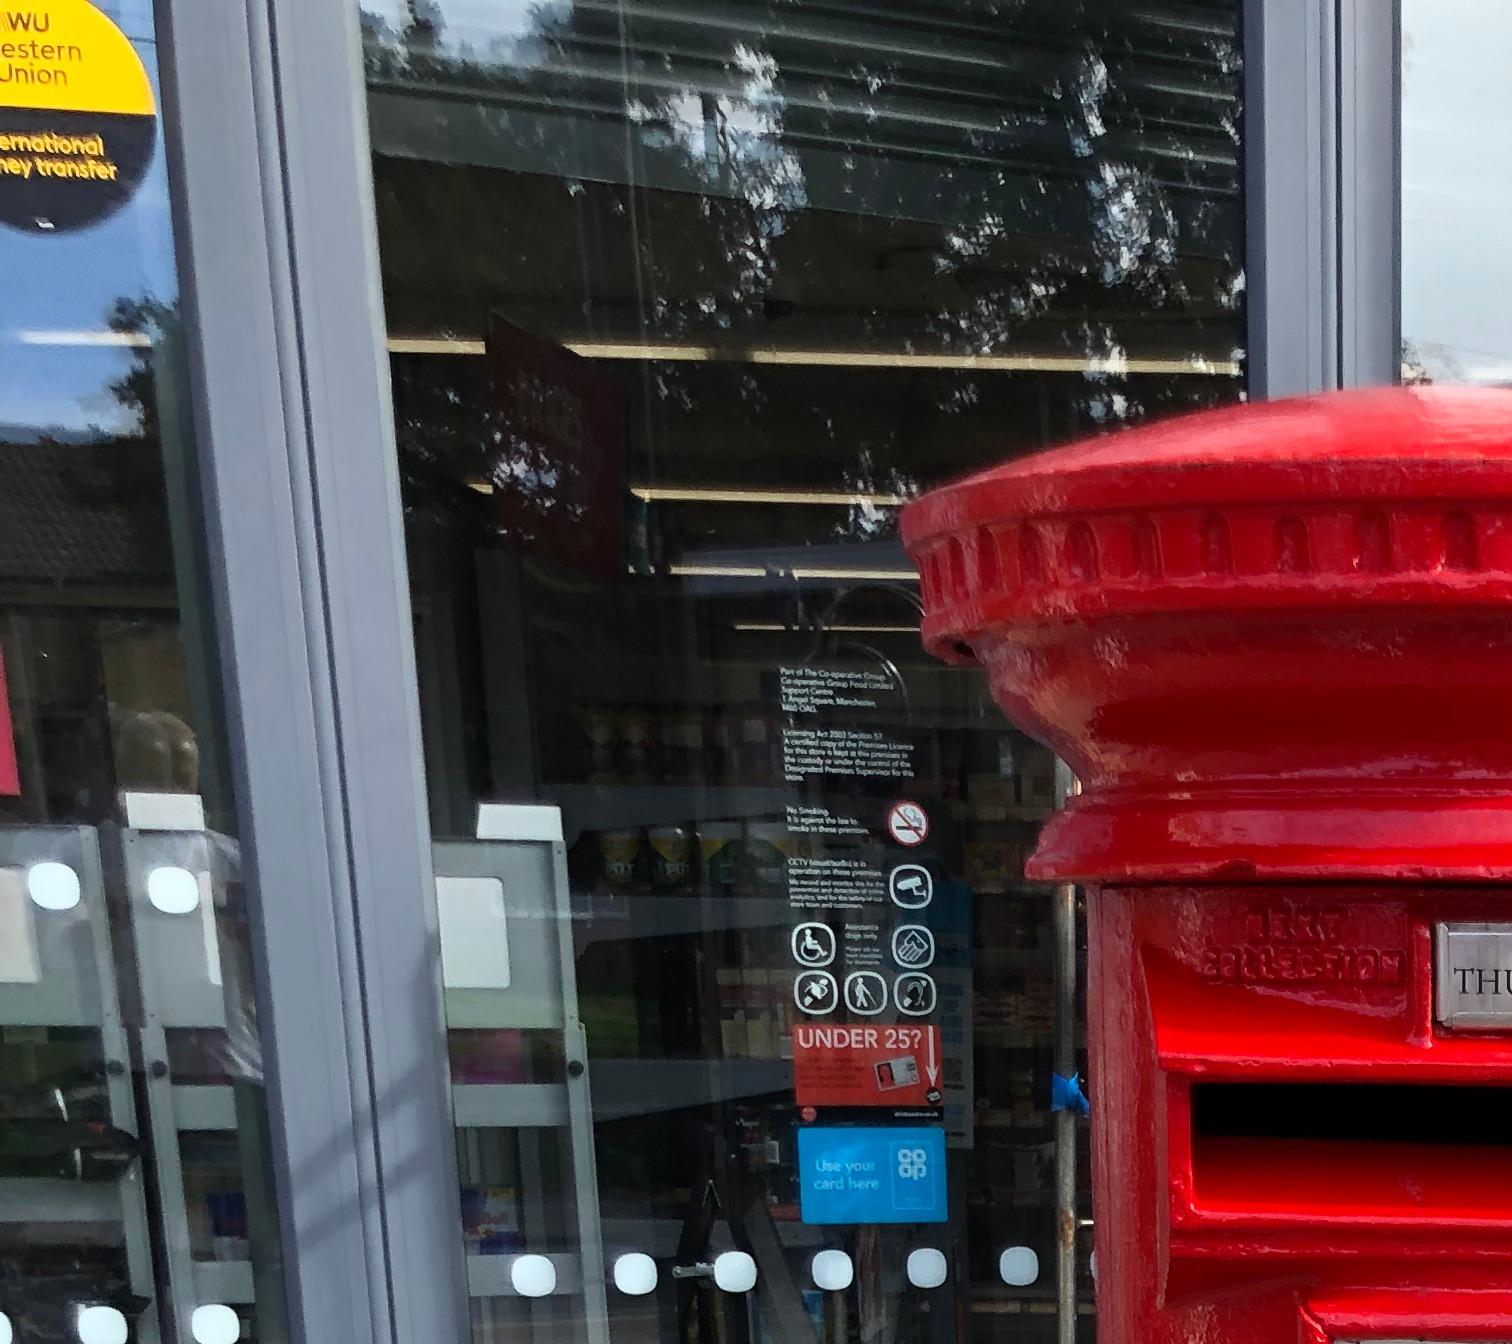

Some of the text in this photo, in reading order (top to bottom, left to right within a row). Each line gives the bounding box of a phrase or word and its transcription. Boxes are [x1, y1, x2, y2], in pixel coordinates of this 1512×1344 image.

[7, 12, 49, 33] WU
[0, 40, 82, 62] estern
[0, 132, 105, 157] ernational
[0, 156, 119, 182] ney transfer
[1203, 945, 1408, 986] COLLECTION
[798, 1028, 878, 1049] UNDER
[885, 1028, 921, 1049] 25?
[815, 1159, 876, 1175] Use your
[814, 1176, 880, 1190] card here
